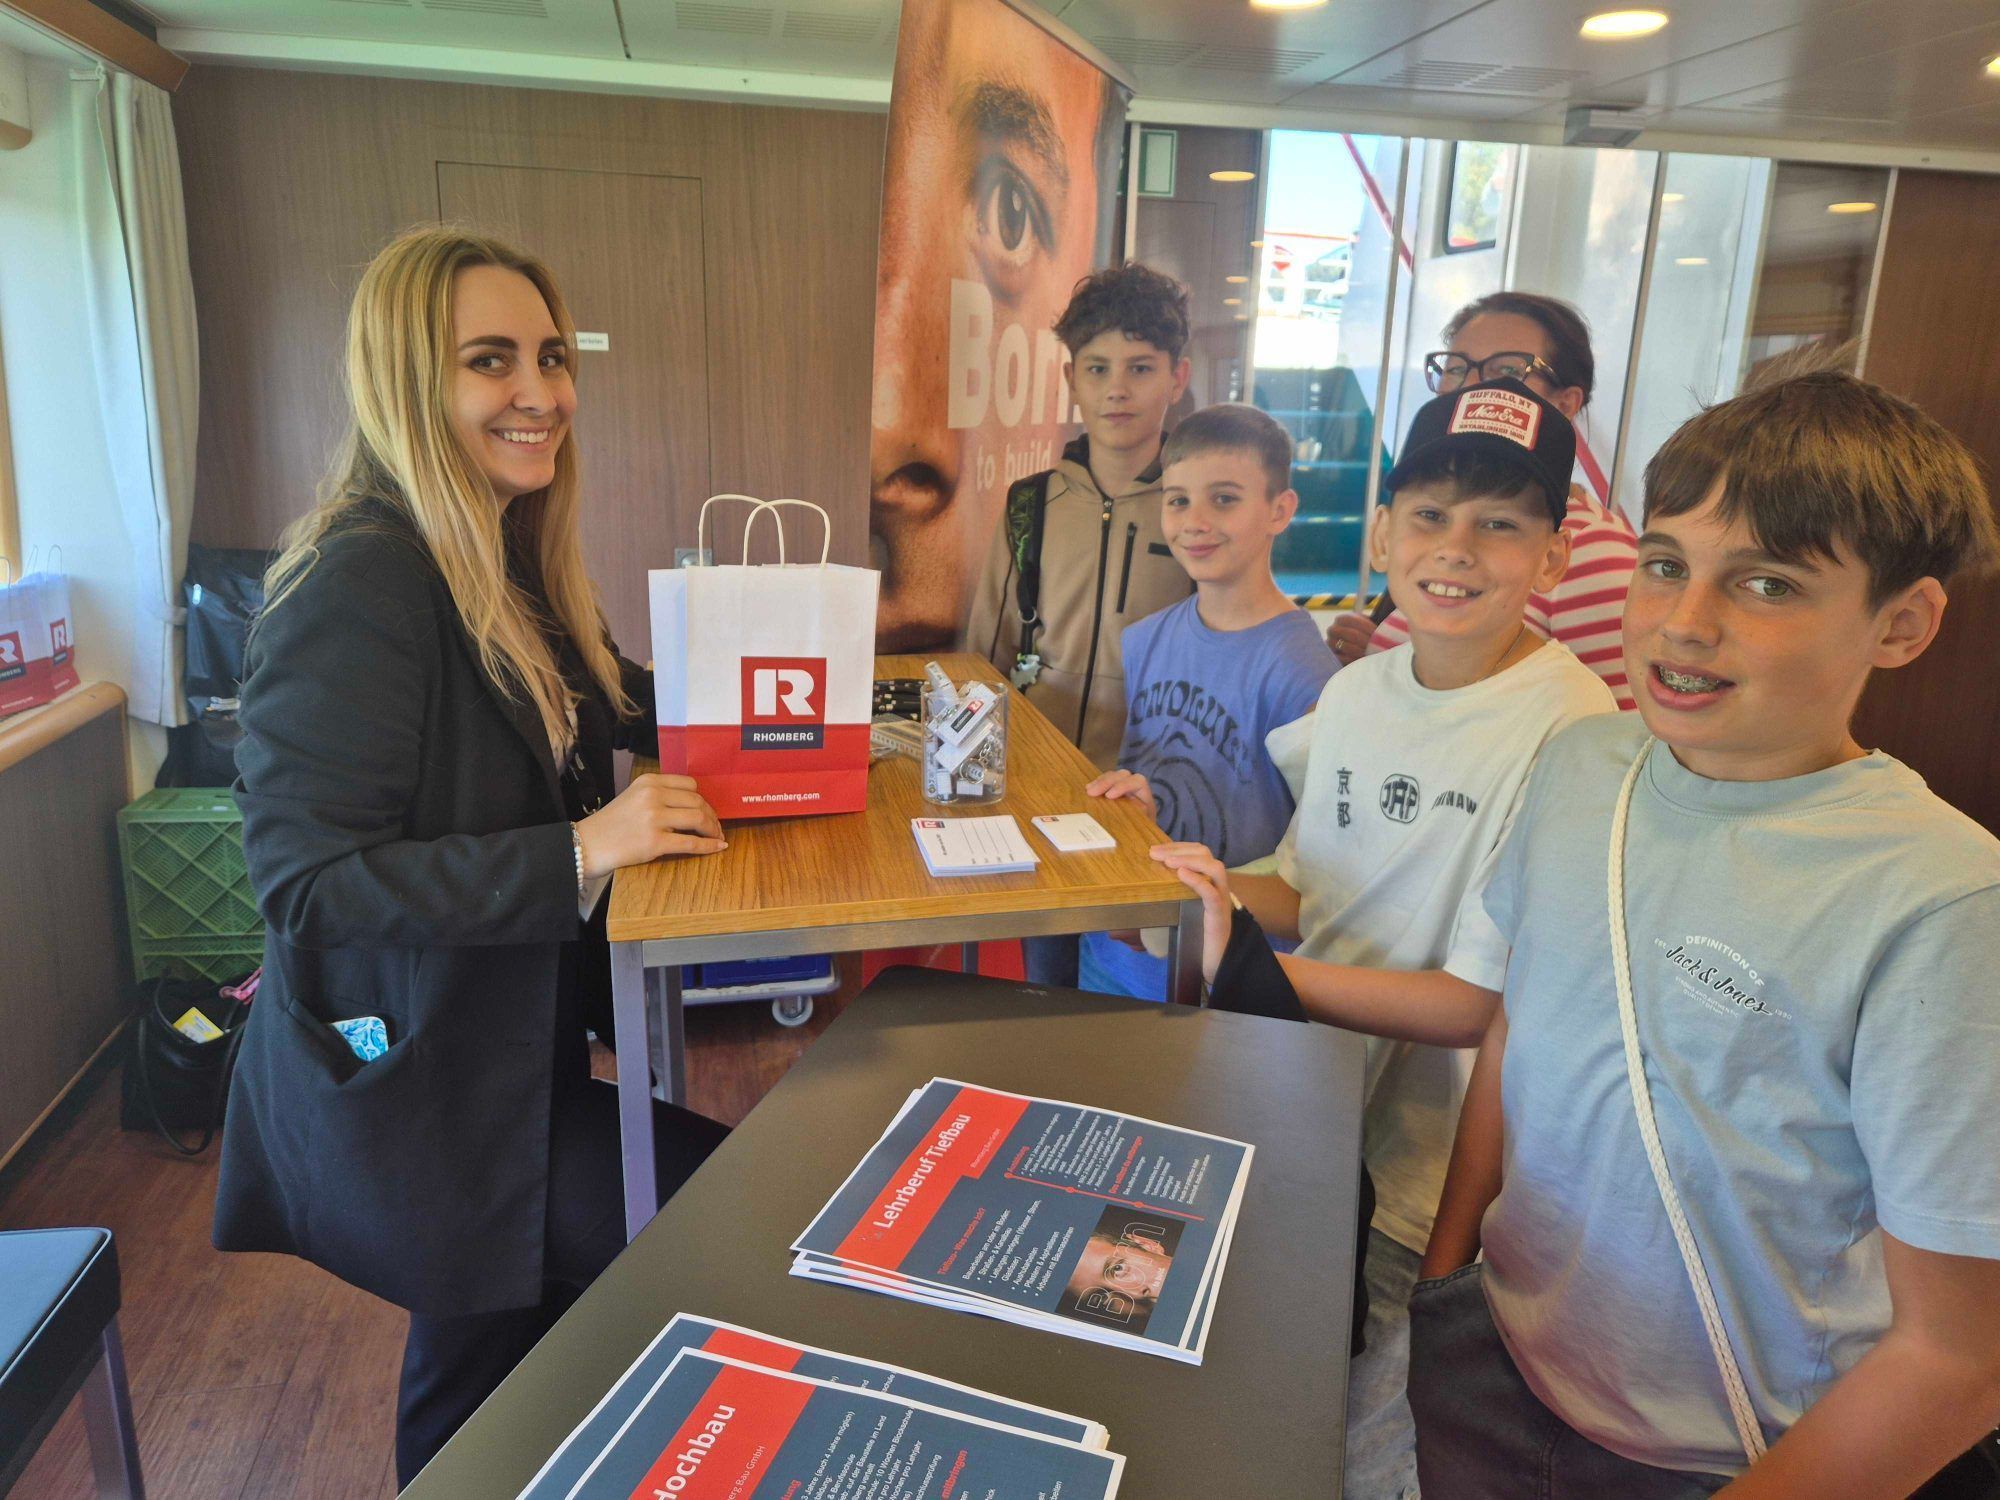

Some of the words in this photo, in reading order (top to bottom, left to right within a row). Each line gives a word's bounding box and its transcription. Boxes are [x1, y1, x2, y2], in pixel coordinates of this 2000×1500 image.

[976, 445, 995, 491] to
[1003, 440, 1052, 486] build
[753, 732, 814, 743] RHOMBERG
[742, 792, 820, 803] www.rhomberg.com
[1686, 935, 1750, 970] DEFINITION
[1749, 969, 1765, 986] OF
[873, 1157, 936, 1228] Lehrberuf
[925, 1114, 971, 1156] Tiefbau
[962, 1251, 985, 1279] Bauarbeiten
[987, 1231, 996, 1243] oder
[990, 1255, 1009, 1278] Leitungen
[1005, 1234, 1020, 1254] verlegen
[1024, 1266, 1041, 1287] Pflastern
[1039, 1231, 1059, 1260] Asphaltieren
[1051, 1227, 1074, 1261] Baumaschinen
[1013, 1247, 1038, 1285] Aushubarbeiten
[1036, 1270, 1052, 1291] Arbeiten
[1048, 1261, 1057, 1270] mit
[1077, 1217, 1166, 1320] Born
[870, 1431, 879, 1439] im
[874, 1415, 887, 1430] Land
[735, 1470, 750, 1485] Bau
[746, 1445, 765, 1469] GmbH
[805, 1476, 819, 1494] Jahre
[814, 1458, 828, 1476] (auch
[828, 1436, 841, 1453] Jahre
[837, 1411, 855, 1435] möglich)
[856, 1439, 875, 1466] Baustelle
[865, 1479, 880, 1500] schule:
[879, 1444, 897, 1468] Wochen
[892, 1409, 913, 1443] Blockschule
[906, 1440, 922, 1465] Lehrjahr
[830, 1454, 855, 1493] Berufsschule
[846, 1476, 857, 1488] auf
[851, 1466, 862, 1478] der
[884, 1458, 901, 1484] Lehrjahr
[902, 1466, 911, 1477] pro
[915, 1454, 942, 1500] schlussprüfung
[942, 1450, 967, 1497] mitbringen
[814, 1475, 832, 1500] bildung:
[880, 1484, 889, 1495] pro
[1049, 1481, 1062, 1500] beiten
